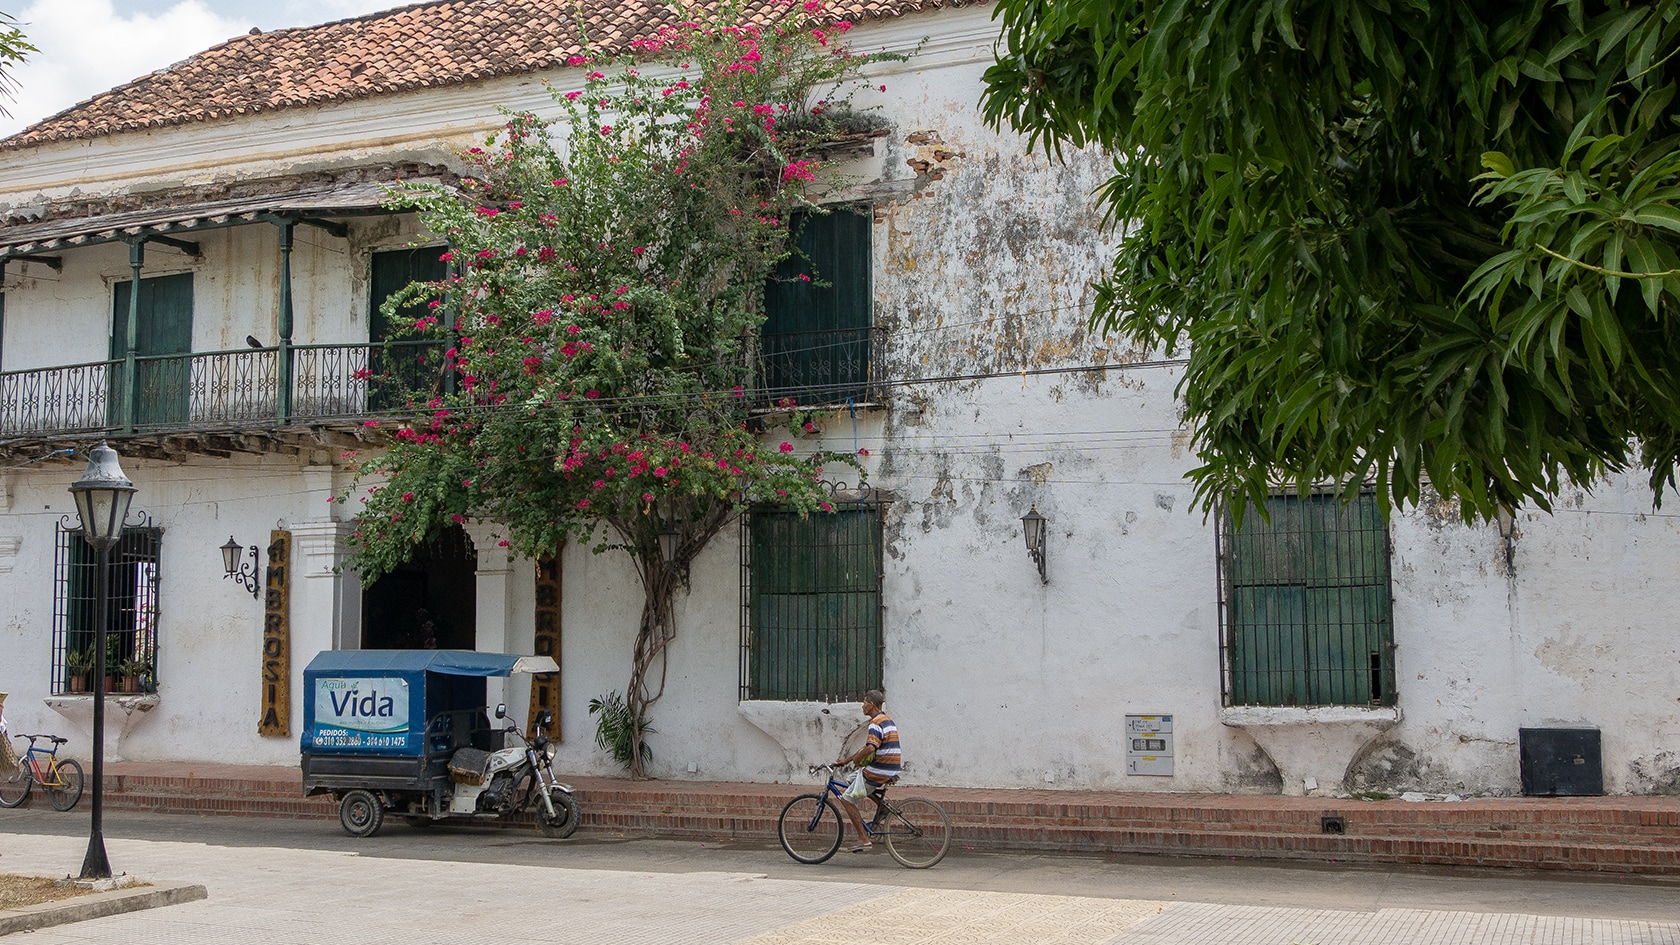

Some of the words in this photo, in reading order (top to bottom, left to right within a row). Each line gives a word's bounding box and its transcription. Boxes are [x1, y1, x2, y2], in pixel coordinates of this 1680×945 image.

[262, 538, 284, 729] AMBROSIA
[330, 690, 394, 717] Vida
[323, 737, 335, 746] 310
[335, 737, 347, 746] 352
[391, 737, 405, 746] 1475
